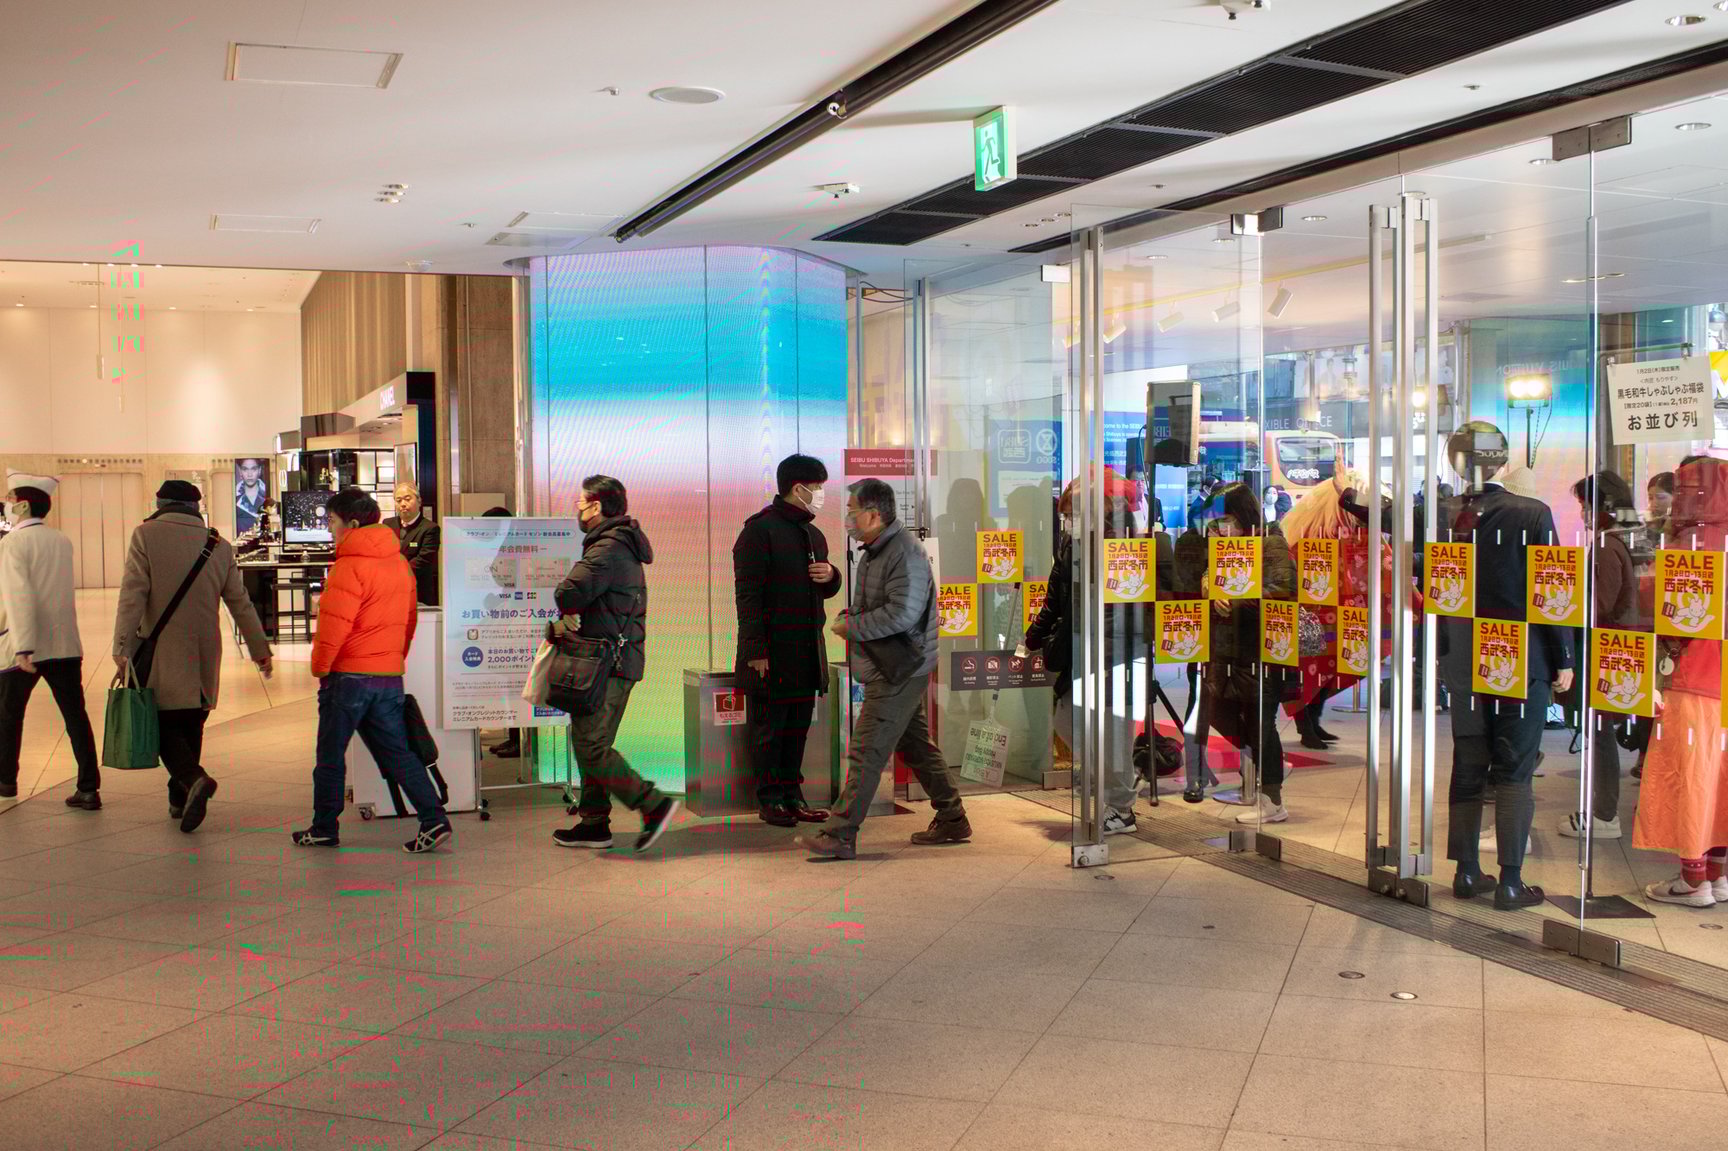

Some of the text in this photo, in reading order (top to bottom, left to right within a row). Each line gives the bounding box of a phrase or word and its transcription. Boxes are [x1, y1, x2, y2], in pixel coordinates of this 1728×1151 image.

[1618, 382, 1704, 399] 黒毛和牛しゃぶしゃぶ福袋
[1627, 411, 1698, 431] お並び列
[983, 533, 1017, 543] SALE
[1216, 539, 1254, 550] SALE
[499, 545, 539, 553] 年会費無料
[983, 548, 1017, 557] 西武冬市
[1108, 542, 1148, 553] SALE
[1303, 542, 1332, 554] SALE
[1431, 546, 1467, 559] SALE
[1216, 557, 1254, 568] 西武冬市
[1534, 549, 1576, 564] SALE
[1664, 554, 1714, 570] SALE
[1108, 559, 1148, 571] 西武冬市
[1303, 560, 1332, 573] 西武冬市
[1431, 566, 1467, 580] 西武冬市
[1534, 571, 1576, 586] 西武冬市
[1664, 578, 1714, 595] 西武冬市
[1163, 603, 1202, 614] SALE
[1265, 603, 1293, 615] SALE
[1163, 621, 1202, 632] 西武冬市
[1265, 620, 1293, 634] 西武冬市
[1480, 622, 1519, 637] SALE
[1600, 633, 1645, 650] SALE
[1480, 643, 1519, 659] 西武冬市
[1599, 656, 1645, 674] 西武冬市
